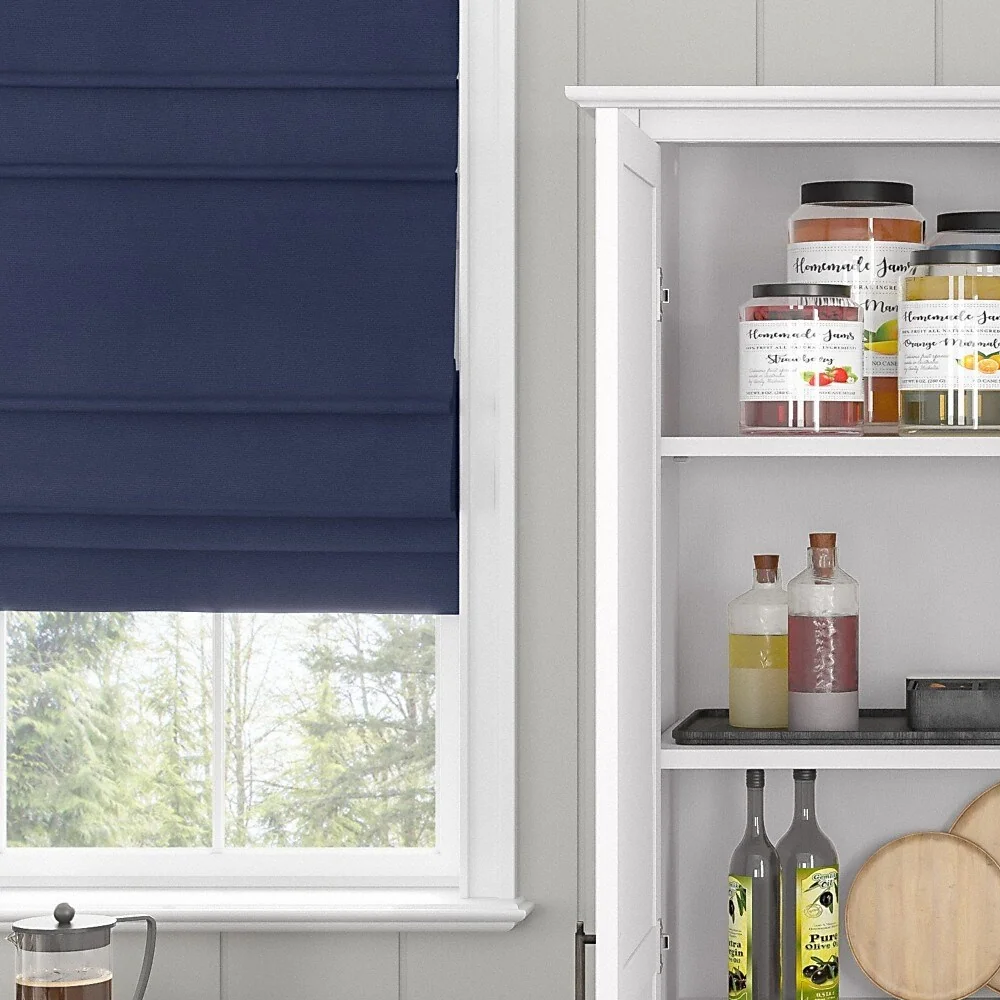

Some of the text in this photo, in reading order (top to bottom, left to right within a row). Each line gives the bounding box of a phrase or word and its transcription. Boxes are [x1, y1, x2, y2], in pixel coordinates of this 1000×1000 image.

[793, 256, 870, 274] Homemade
[903, 310, 974, 323] Homemade
[747, 328, 855, 342] Homemade Jams
[903, 338, 938, 350] Orange
[765, 354, 834, 365] Strawberry
